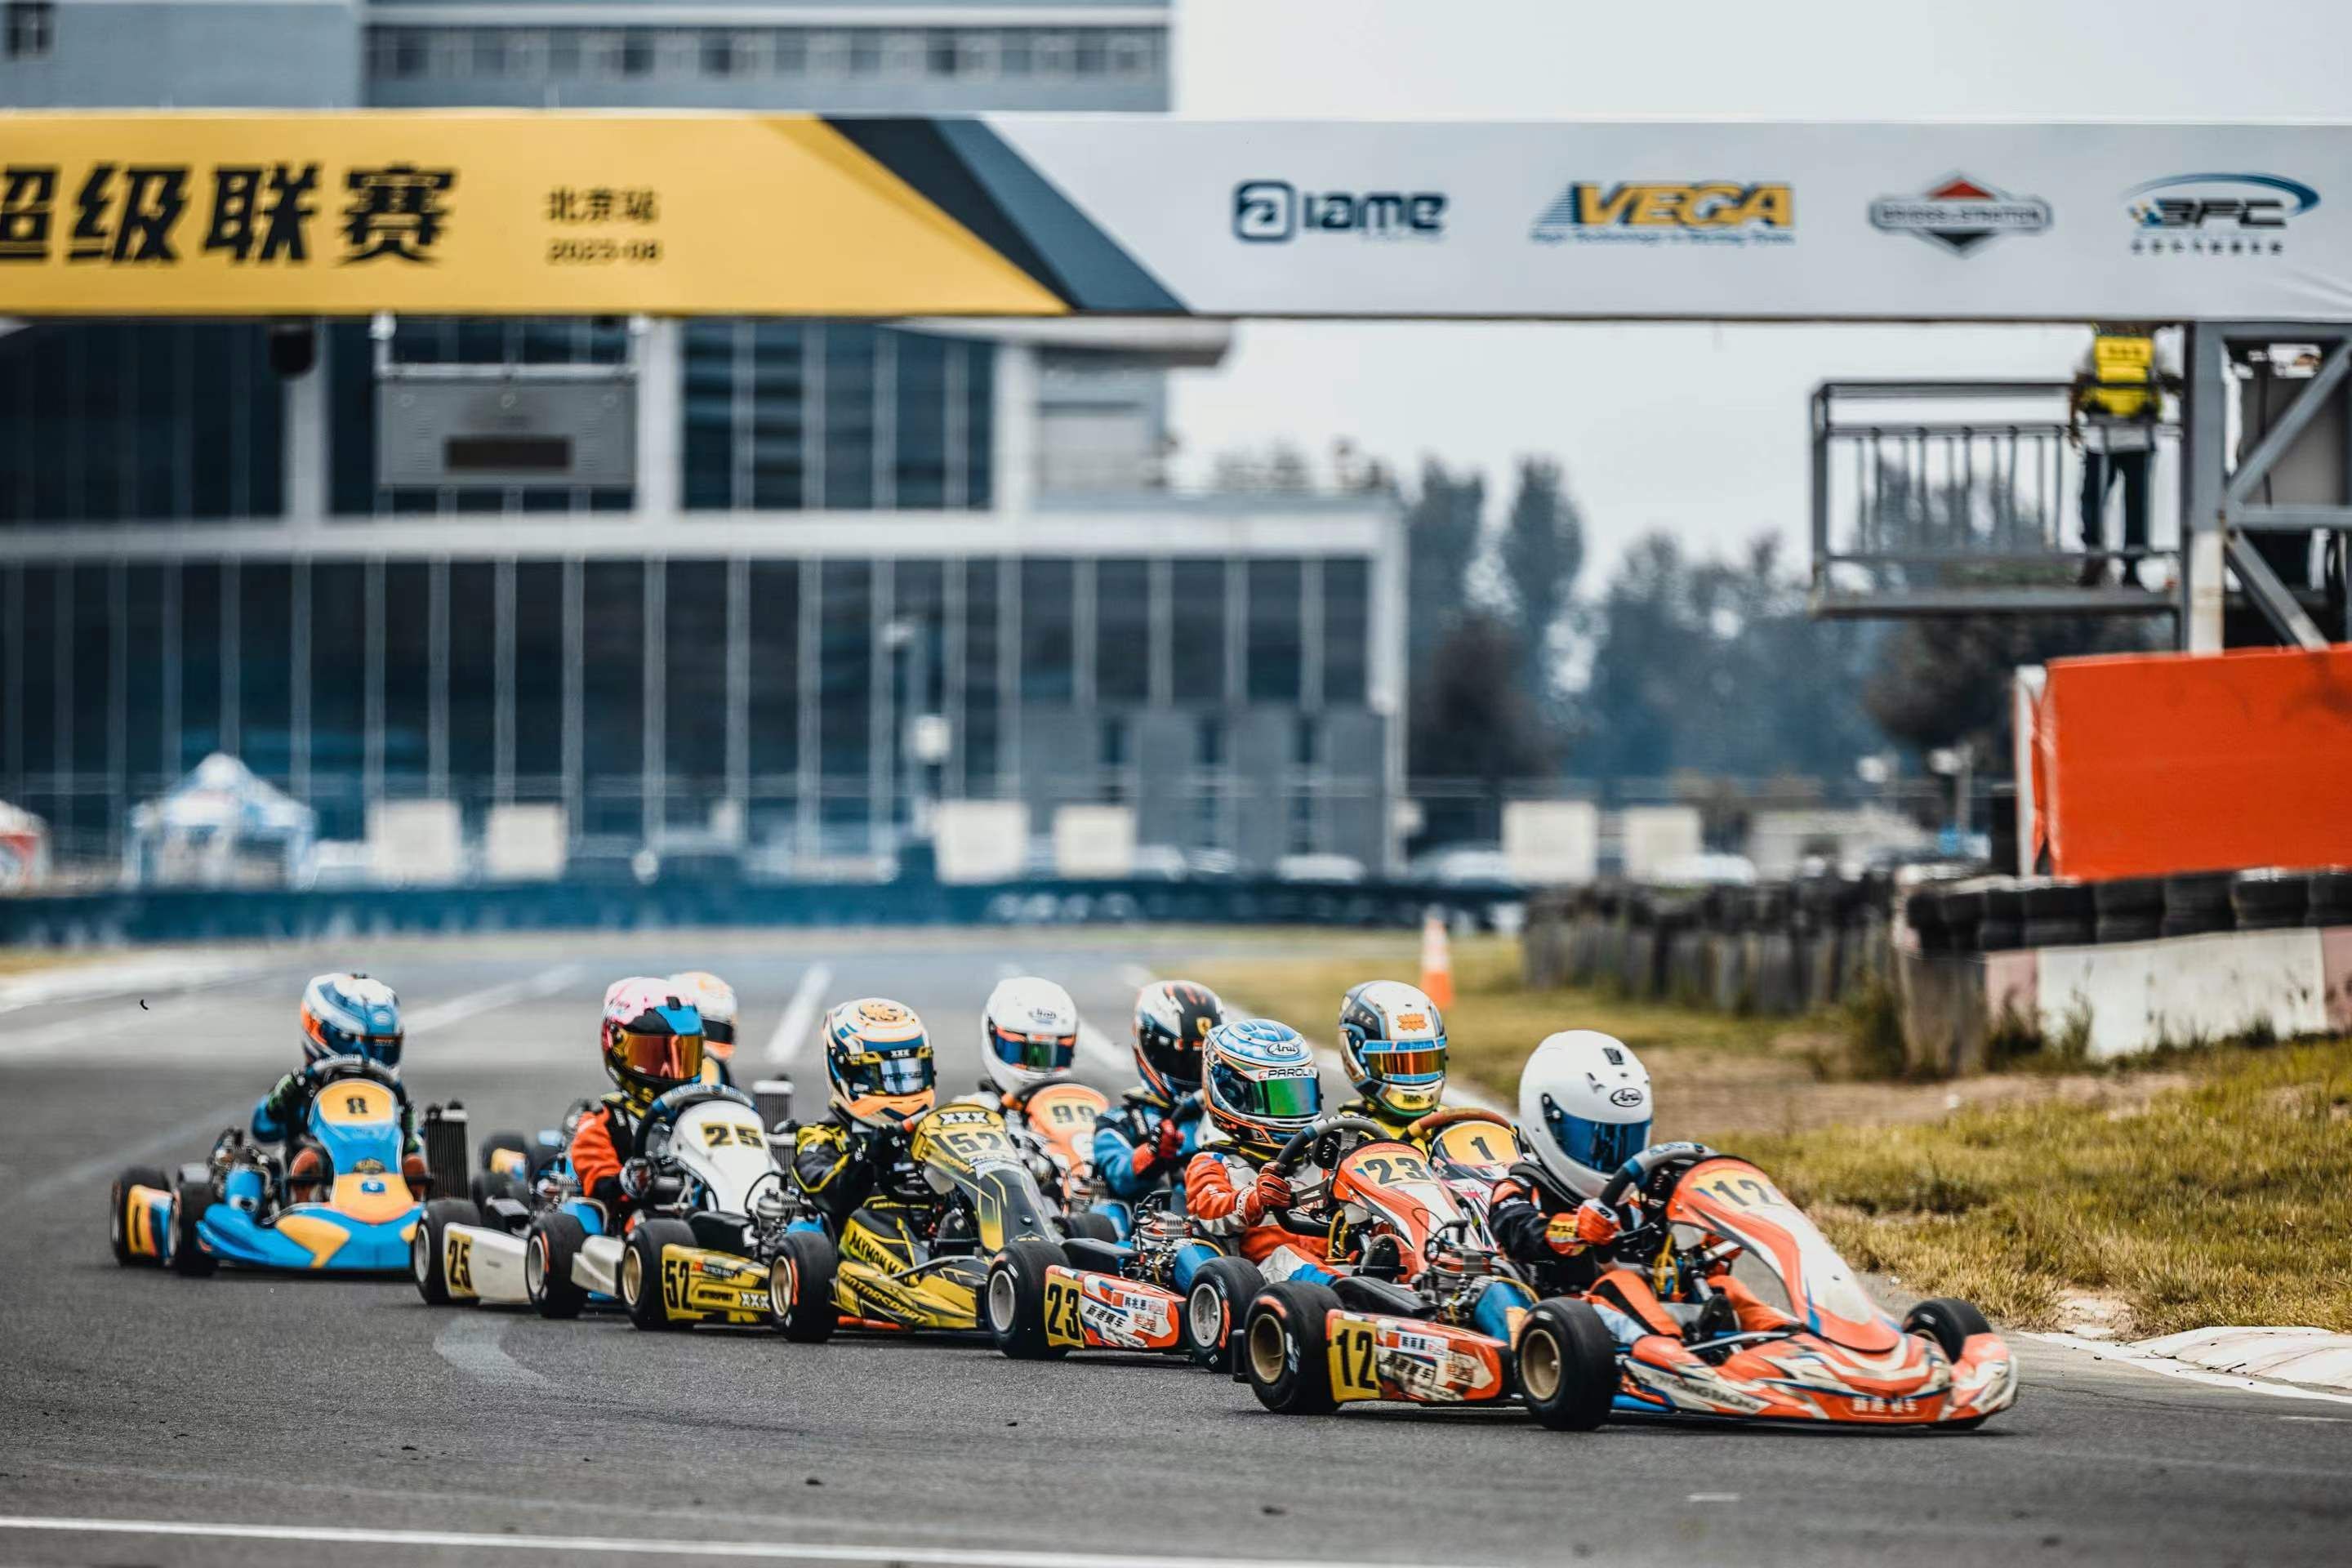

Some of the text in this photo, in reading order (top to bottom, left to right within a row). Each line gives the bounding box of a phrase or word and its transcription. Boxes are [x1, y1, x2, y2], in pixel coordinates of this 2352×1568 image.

[1570, 180, 1795, 228] VEGA
[704, 1126, 763, 1148] 25
[1470, 1136, 1495, 1161] 1
[1364, 1157, 1431, 1185] 23
[1712, 1179, 1784, 1207] 12
[448, 1240, 472, 1290] 25
[665, 1259, 693, 1310] 52
[1046, 1282, 1081, 1341] 23
[1335, 1328, 1377, 1390] 12
